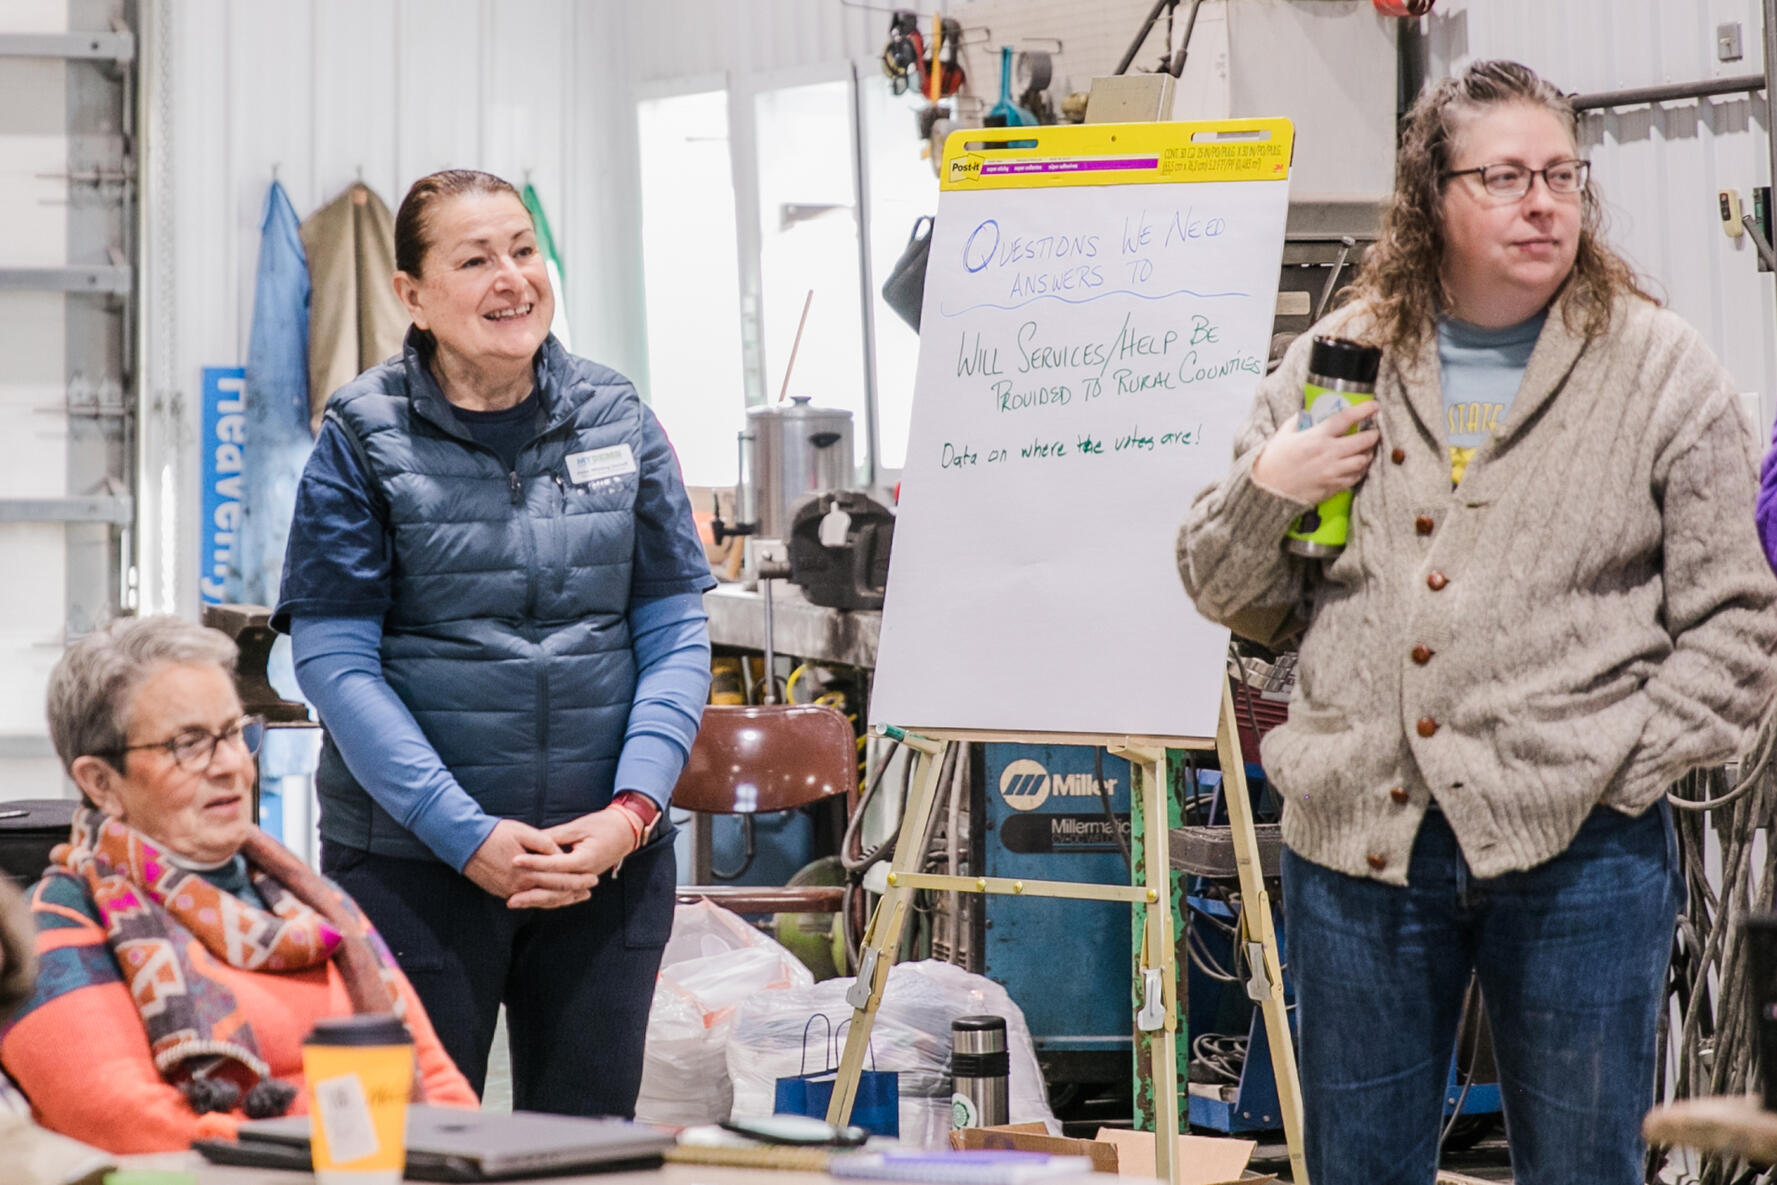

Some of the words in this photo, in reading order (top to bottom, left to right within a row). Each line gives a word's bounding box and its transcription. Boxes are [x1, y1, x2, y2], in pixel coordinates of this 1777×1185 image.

[952, 161, 980, 172] Post-it
[1010, 264, 1104, 298] ANSWERS
[1126, 258, 1153, 285] TO
[1190, 314, 1219, 345] BE
[990, 379, 1072, 413] PROVIDED
[1082, 377, 1102, 402] TO
[1113, 368, 1176, 396] RURAL
[1179, 350, 1261, 384] COUNTIES
[941, 442, 977, 469] Data
[988, 449, 1007, 463] on
[1021, 437, 1067, 458] where
[1077, 434, 1104, 454] the
[1052, 773, 1118, 797] Miller
